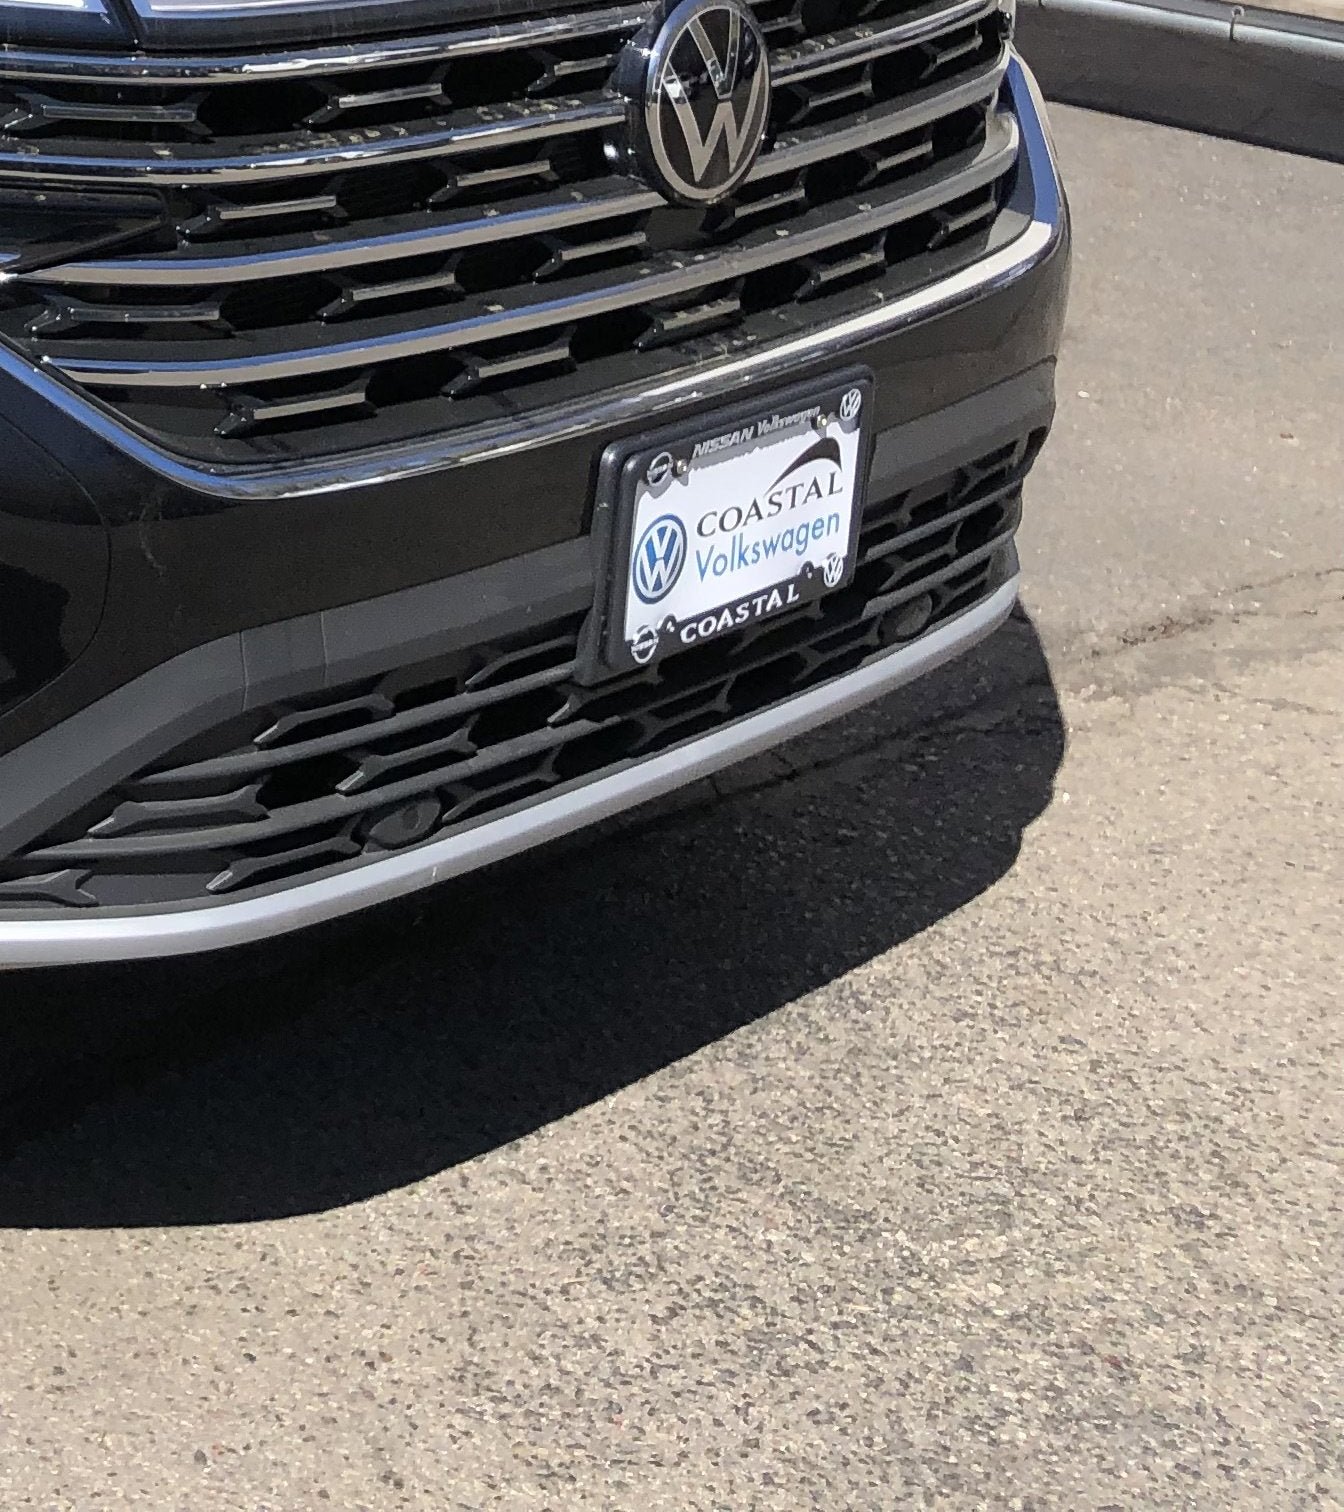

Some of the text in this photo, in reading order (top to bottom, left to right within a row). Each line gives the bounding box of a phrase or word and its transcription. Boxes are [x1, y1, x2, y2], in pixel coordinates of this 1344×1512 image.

[696, 471, 844, 538] COASTAL
[695, 512, 841, 584] Volkswagen
[680, 583, 801, 644] COASTAL
